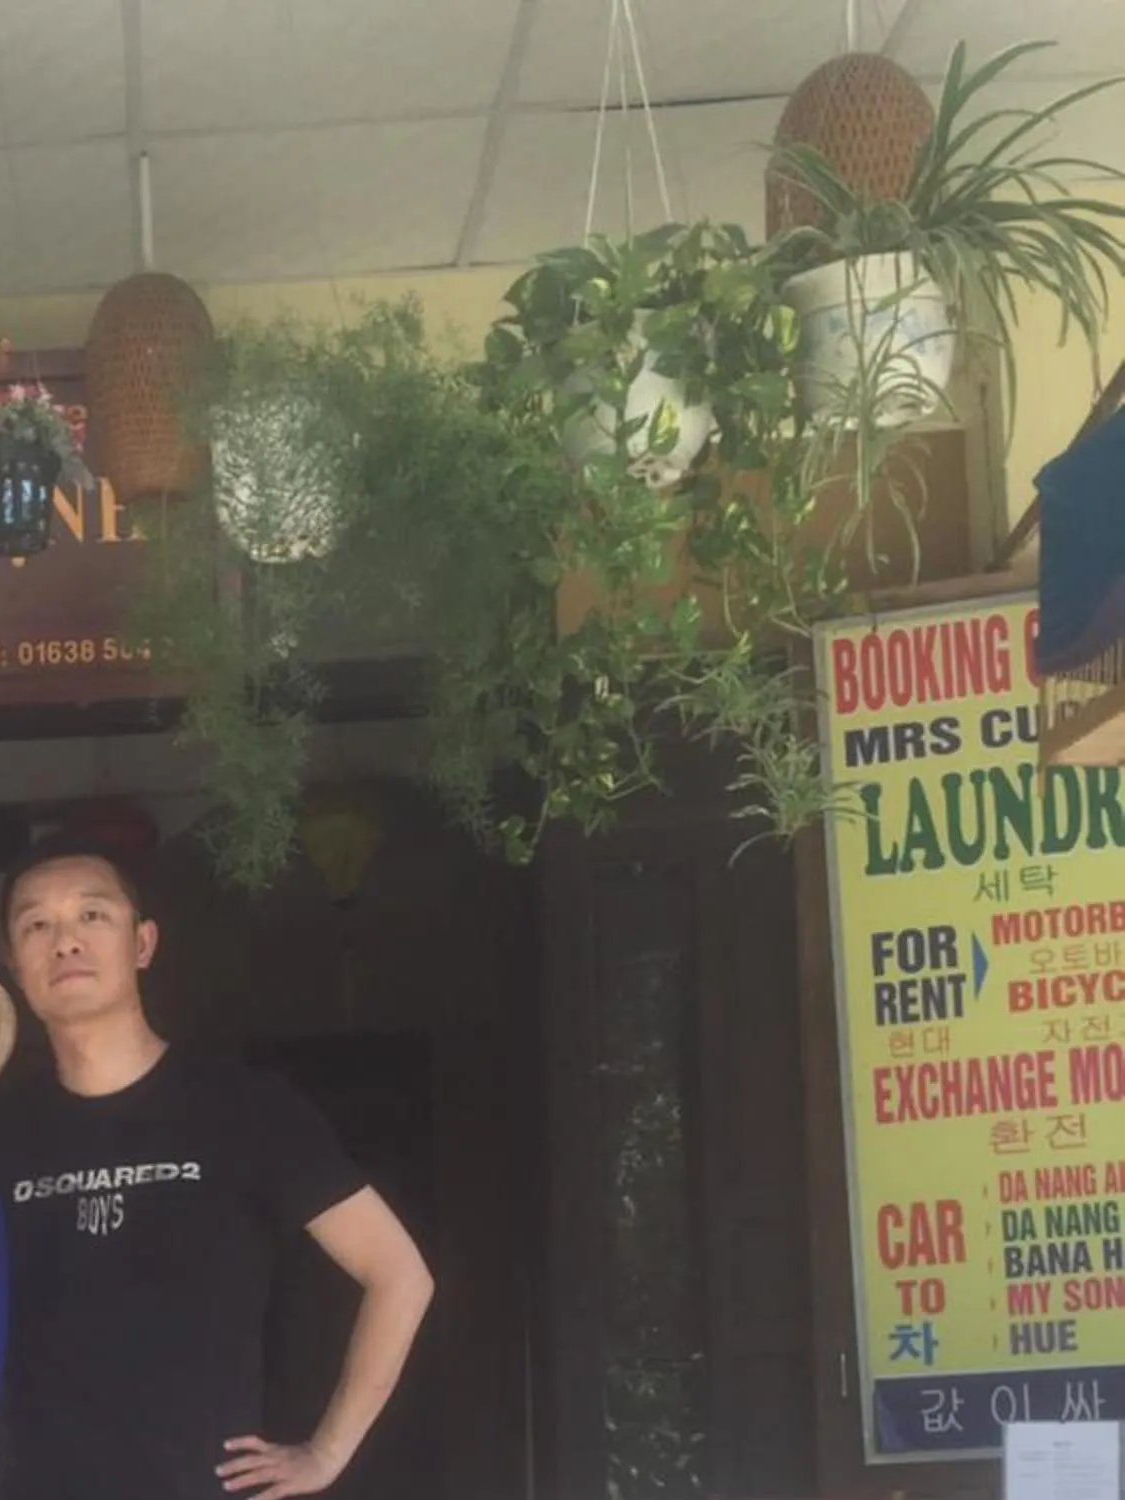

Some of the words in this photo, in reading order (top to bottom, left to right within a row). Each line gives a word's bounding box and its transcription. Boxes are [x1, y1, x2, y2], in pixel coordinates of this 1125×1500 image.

[18, 639, 95, 667] 01638
[832, 612, 1012, 715] BOOKING
[844, 717, 961, 768] MRS
[860, 762, 1125, 877] LAUNDR
[974, 865, 1058, 903] 세탁
[991, 900, 1125, 946] MOTORB
[871, 925, 958, 977] FOR
[874, 973, 966, 1027] RENT
[1008, 969, 1125, 1013] BICYC
[1042, 1013, 1125, 1044] 자전
[873, 1049, 1058, 1124] EXCHANGE
[1069, 1041, 1125, 1105] MO
[13, 1161, 201, 1202] DSQUARED2
[999, 1169, 1027, 1204] DA
[1035, 1163, 1096, 1201] NANG
[76, 1193, 124, 1235] BOYS
[878, 1198, 966, 1270] CAR
[1002, 1207, 1036, 1242] DA
[1044, 1200, 1120, 1239] NANG
[1004, 1241, 1092, 1279] BANA
[896, 1278, 945, 1316] TO
[1007, 1279, 1051, 1316] MY
[1063, 1275, 1125, 1312] SON
[888, 1321, 939, 1365] 차
[1009, 1319, 1078, 1355] HUE
